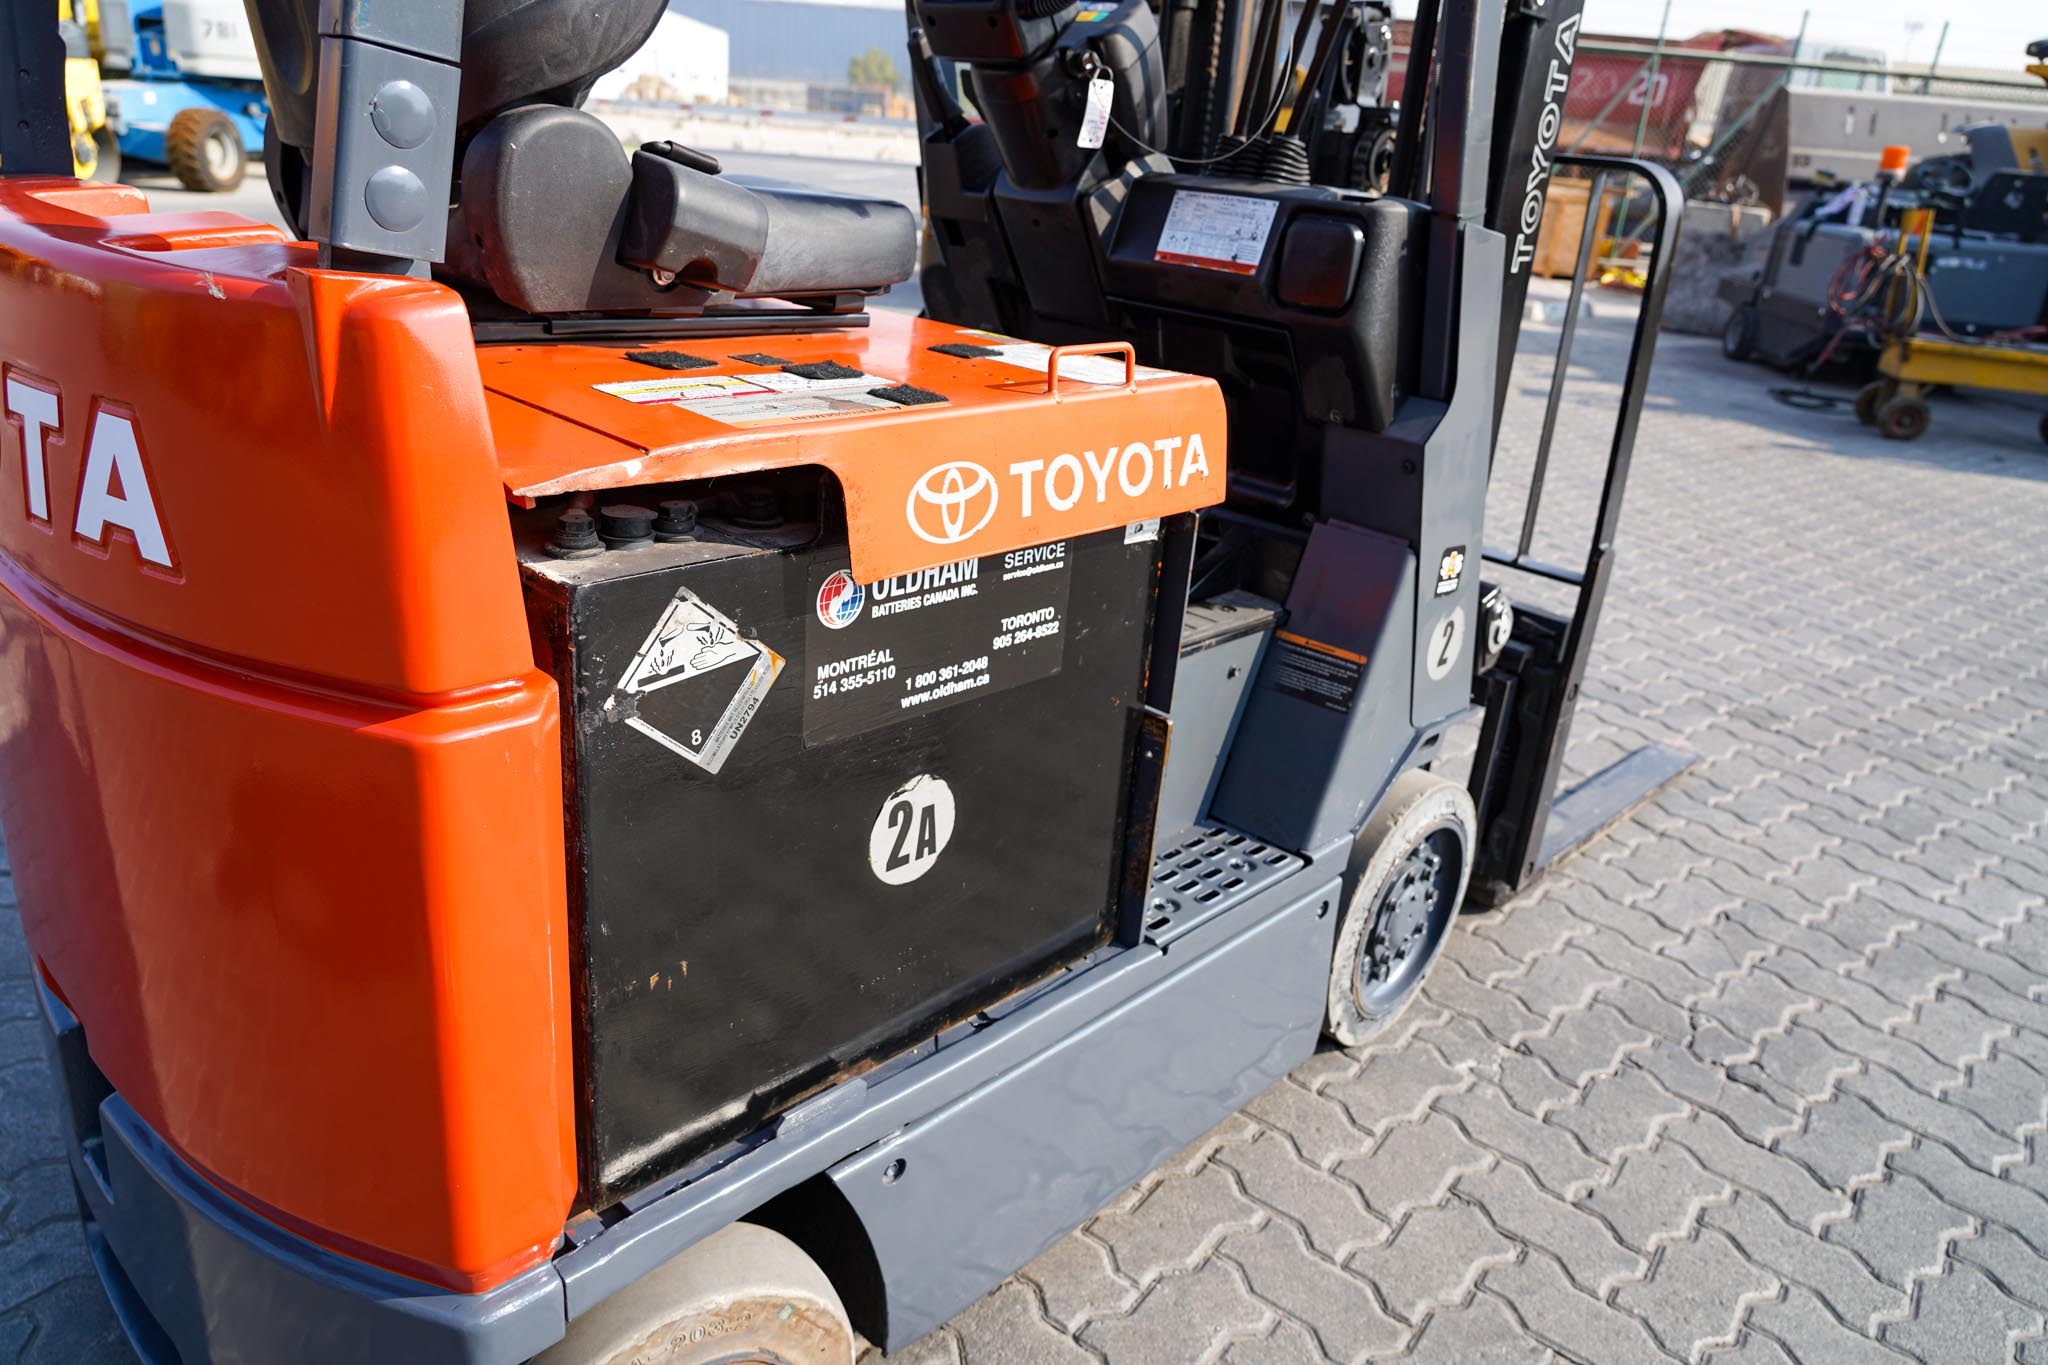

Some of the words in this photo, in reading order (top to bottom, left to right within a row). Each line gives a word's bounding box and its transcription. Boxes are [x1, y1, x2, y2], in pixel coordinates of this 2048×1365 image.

[1510, 13, 1580, 274] TOYOTA
[1009, 433, 1209, 518] TOYOTA
[1002, 561, 1064, 581] service@oldham.ca
[1004, 542, 1066, 569] SERVICE
[871, 557, 979, 601] OLDHAM
[871, 596, 922, 618] BATTERIES
[923, 588, 960, 607] CANADA
[960, 583, 978, 597] INC.
[992, 633, 1012, 651] 905
[1013, 621, 1060, 645] 264-8522
[1000, 606, 1055, 632] TORONTO
[1436, 620, 1455, 668] 2
[813, 681, 838, 699] 514
[839, 664, 897, 693] 355-5110
[817, 649, 894, 680] MONTRÉAL
[905, 676, 911, 691] 1
[915, 669, 937, 689] 800
[938, 656, 989, 680] 361-2048
[900, 673, 990, 709] www.oldham.ca
[729, 697, 759, 740] UN2794
[691, 729, 702, 746] 8
[885, 800, 937, 873] 2A
